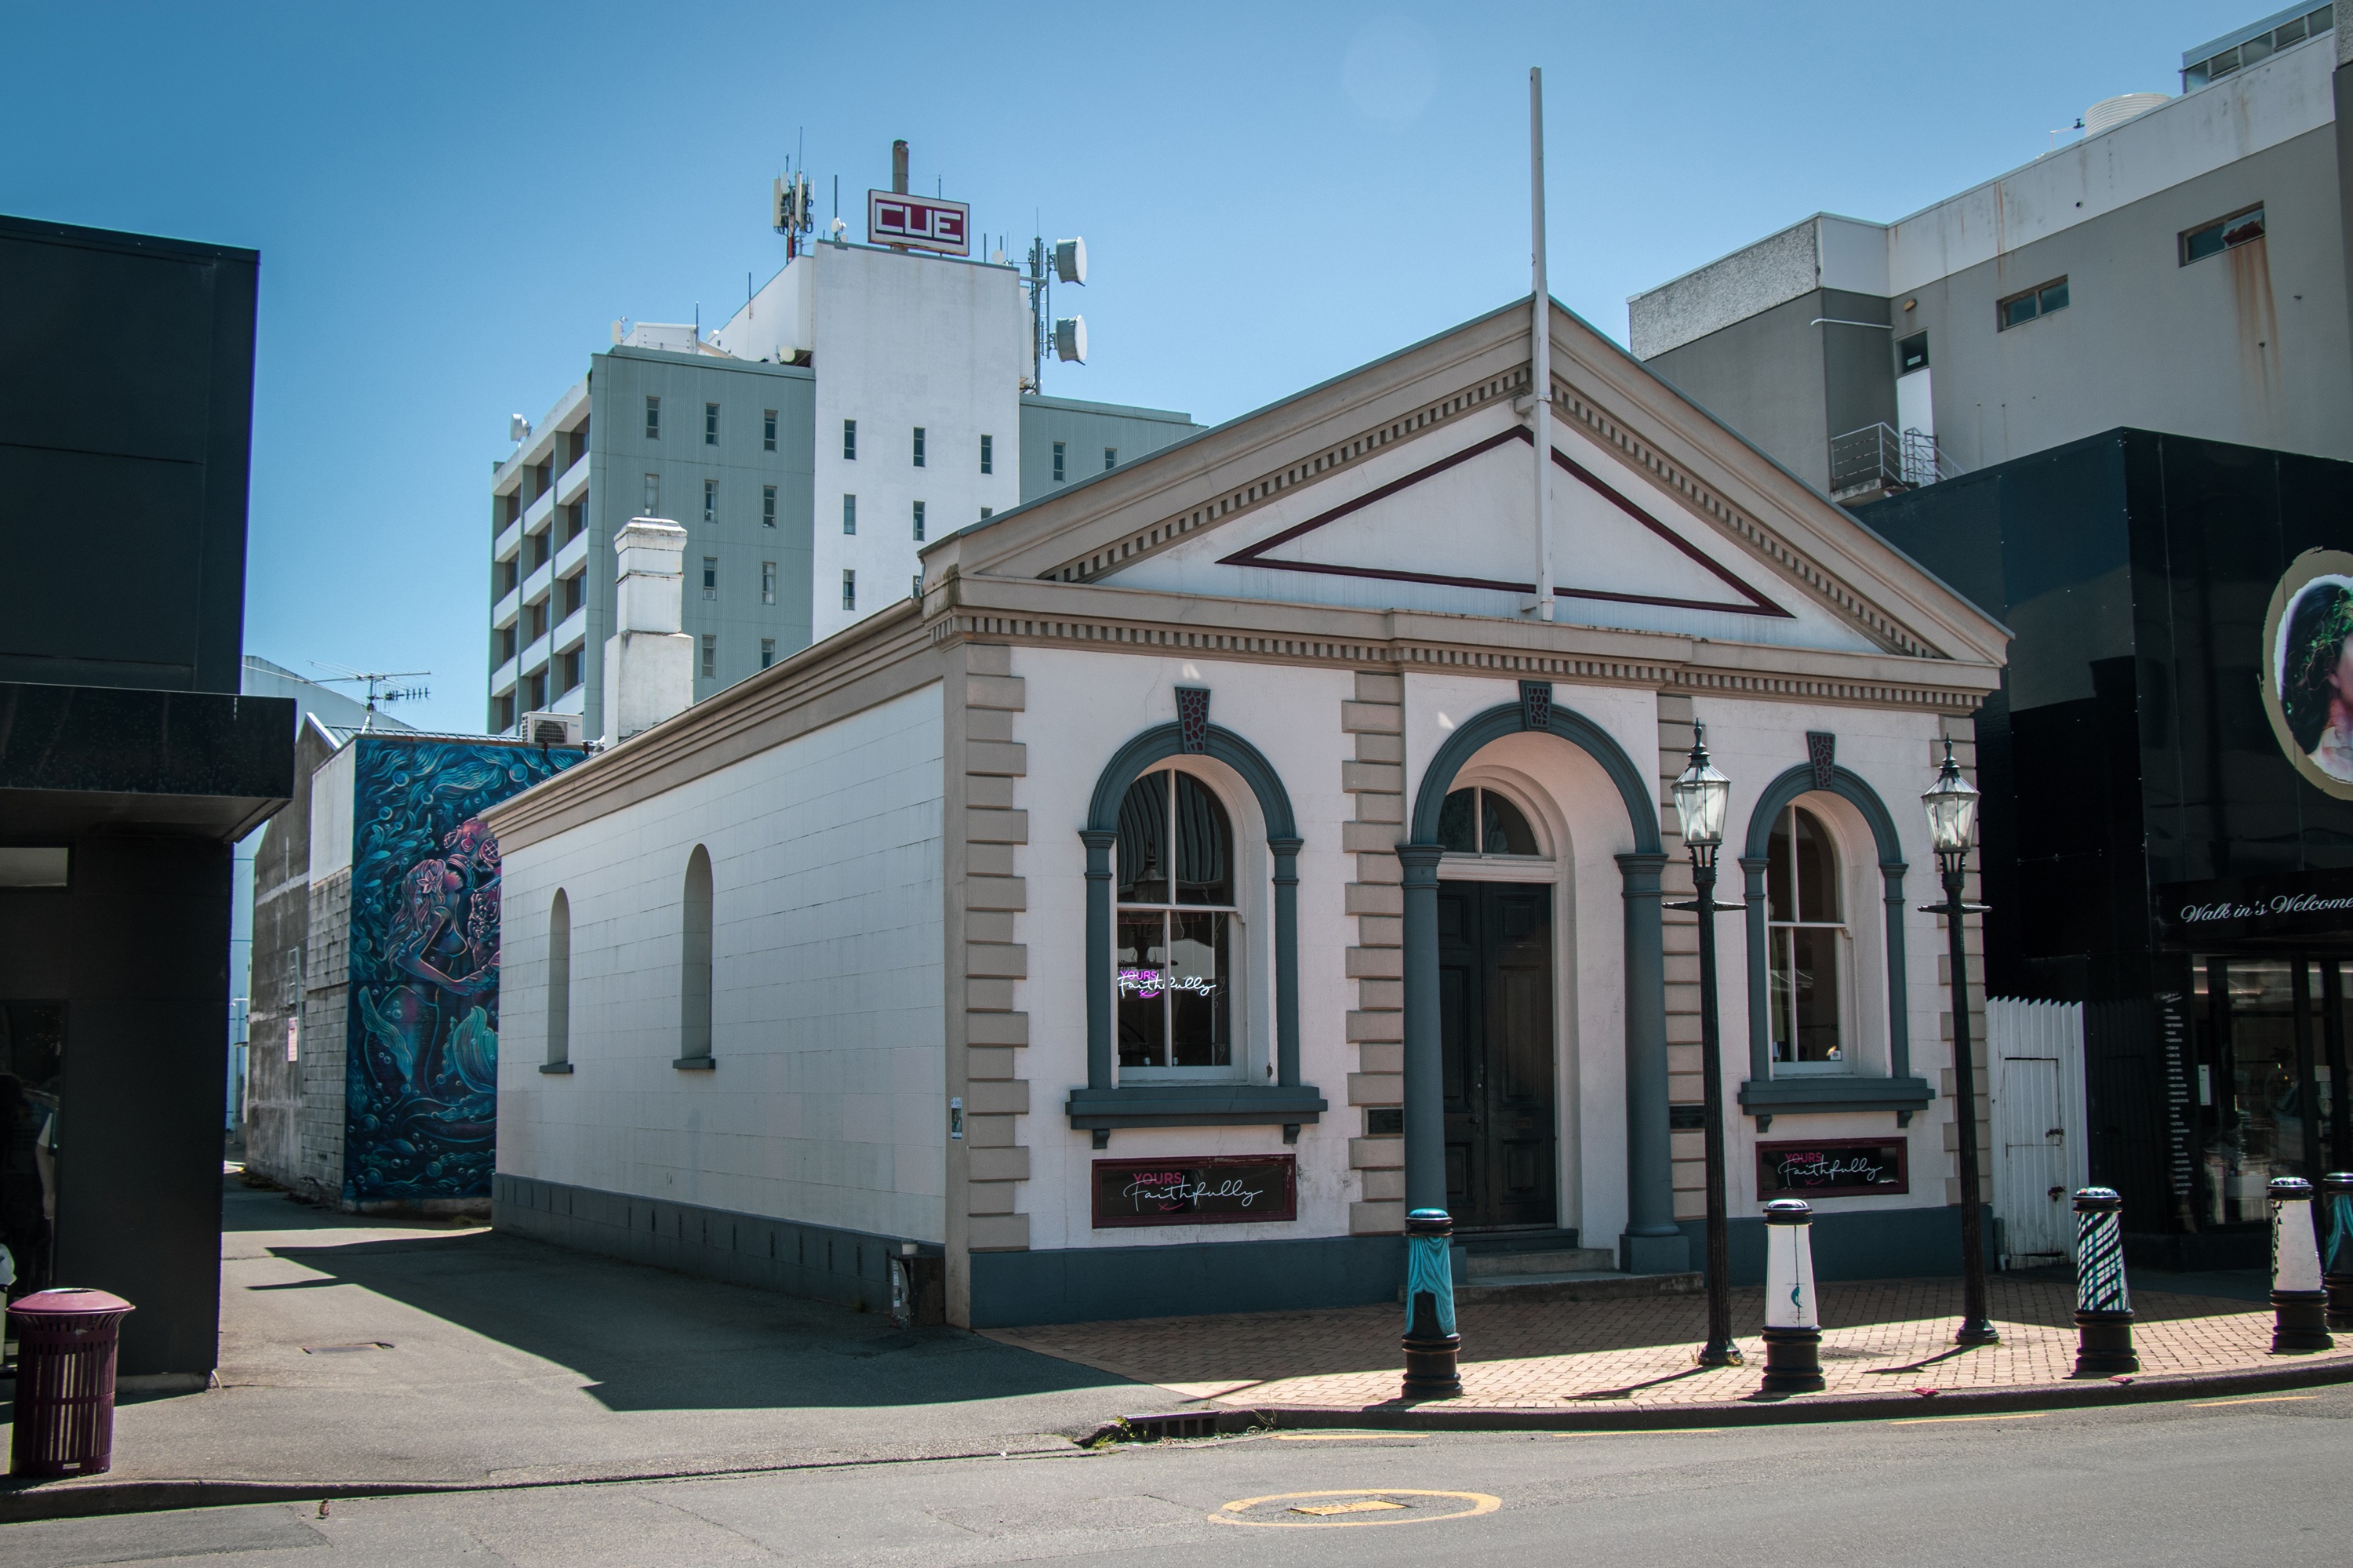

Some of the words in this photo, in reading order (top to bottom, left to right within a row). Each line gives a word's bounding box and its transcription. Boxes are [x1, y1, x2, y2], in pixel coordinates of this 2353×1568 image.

[875, 202, 961, 242] CUE
[2180, 902, 2232, 923] Walk
[2233, 900, 2268, 919] in's
[2270, 893, 2353, 914] Welcome
[1119, 970, 1158, 980] YOURS
[1777, 1154, 1883, 1187] Faithfully
[1785, 1152, 1822, 1163] YOURS
[1123, 1175, 1264, 1212] Faithfully
[1133, 1172, 1182, 1185] YOURS
